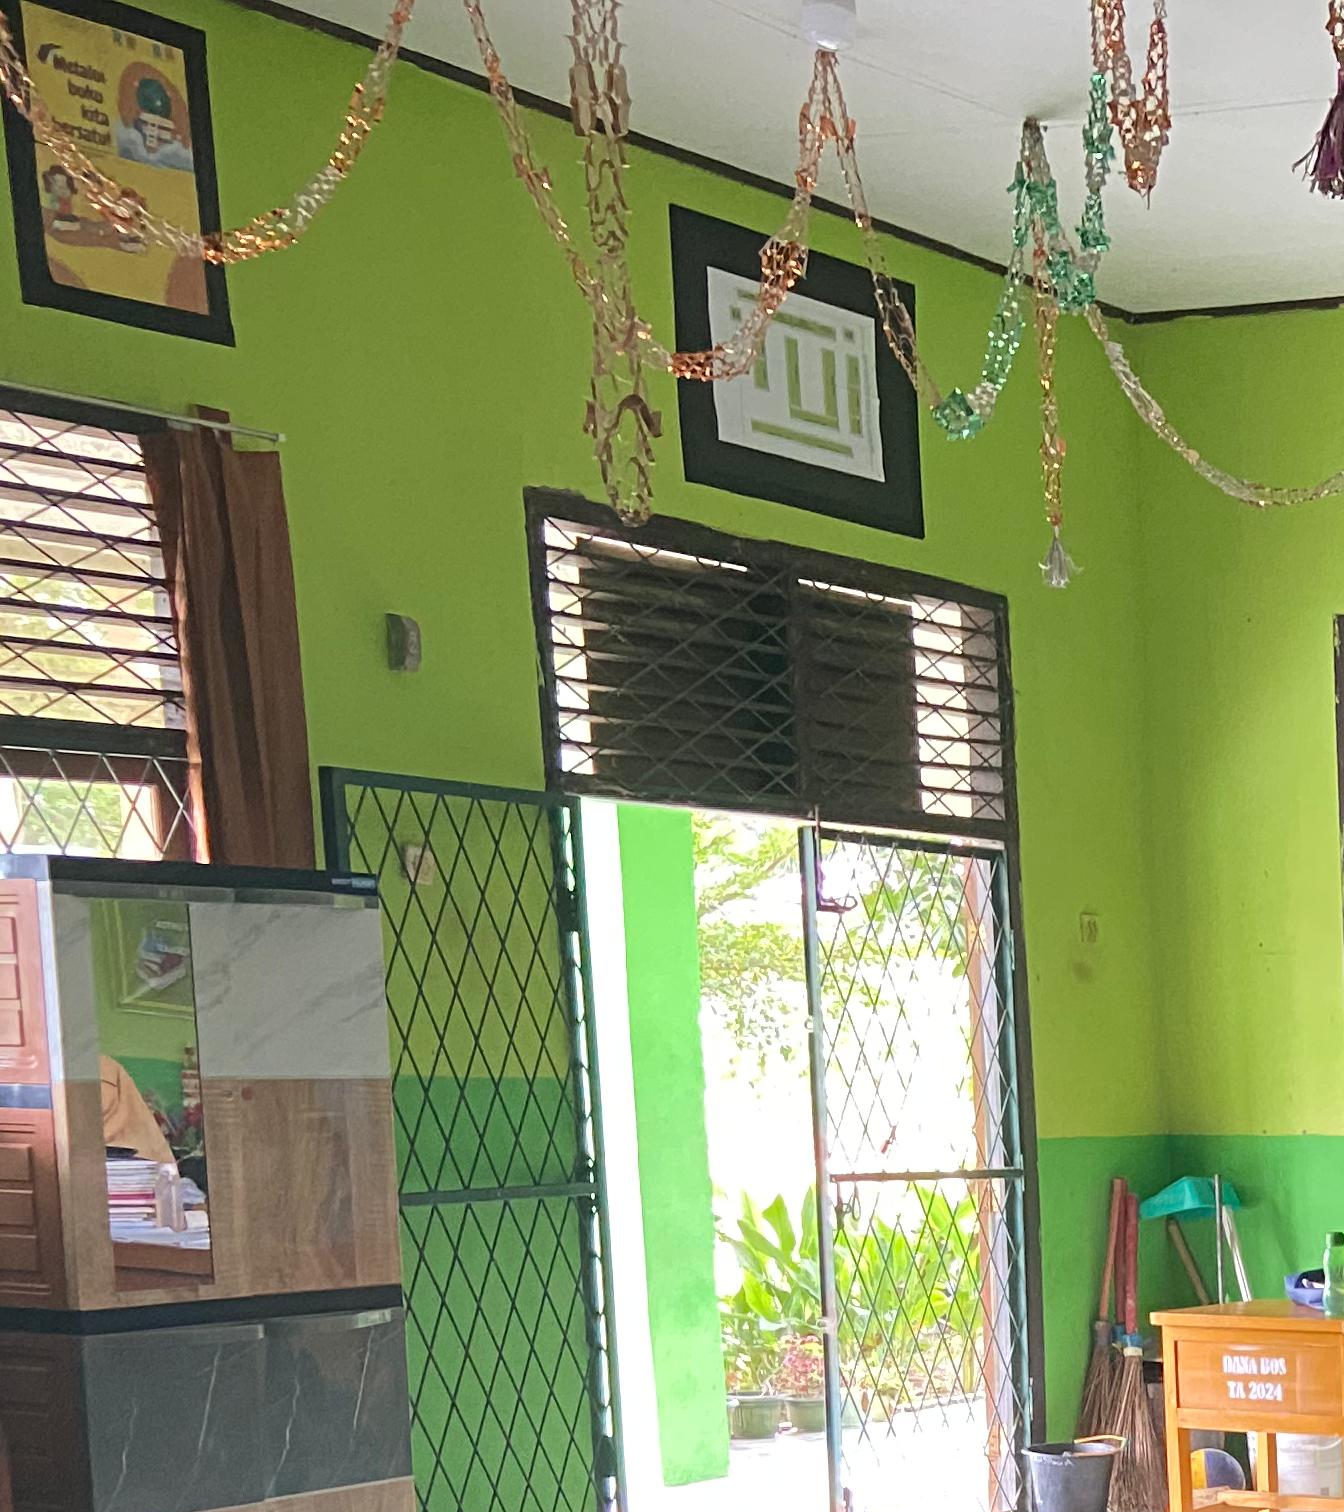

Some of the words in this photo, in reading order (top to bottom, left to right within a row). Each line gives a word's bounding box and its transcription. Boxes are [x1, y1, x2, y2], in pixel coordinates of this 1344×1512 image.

[1223, 1354, 1258, 1375] DANA
[1260, 1356, 1287, 1375] BOS
[1227, 1380, 1246, 1399] TA
[1248, 1381, 1283, 1402] 2024
